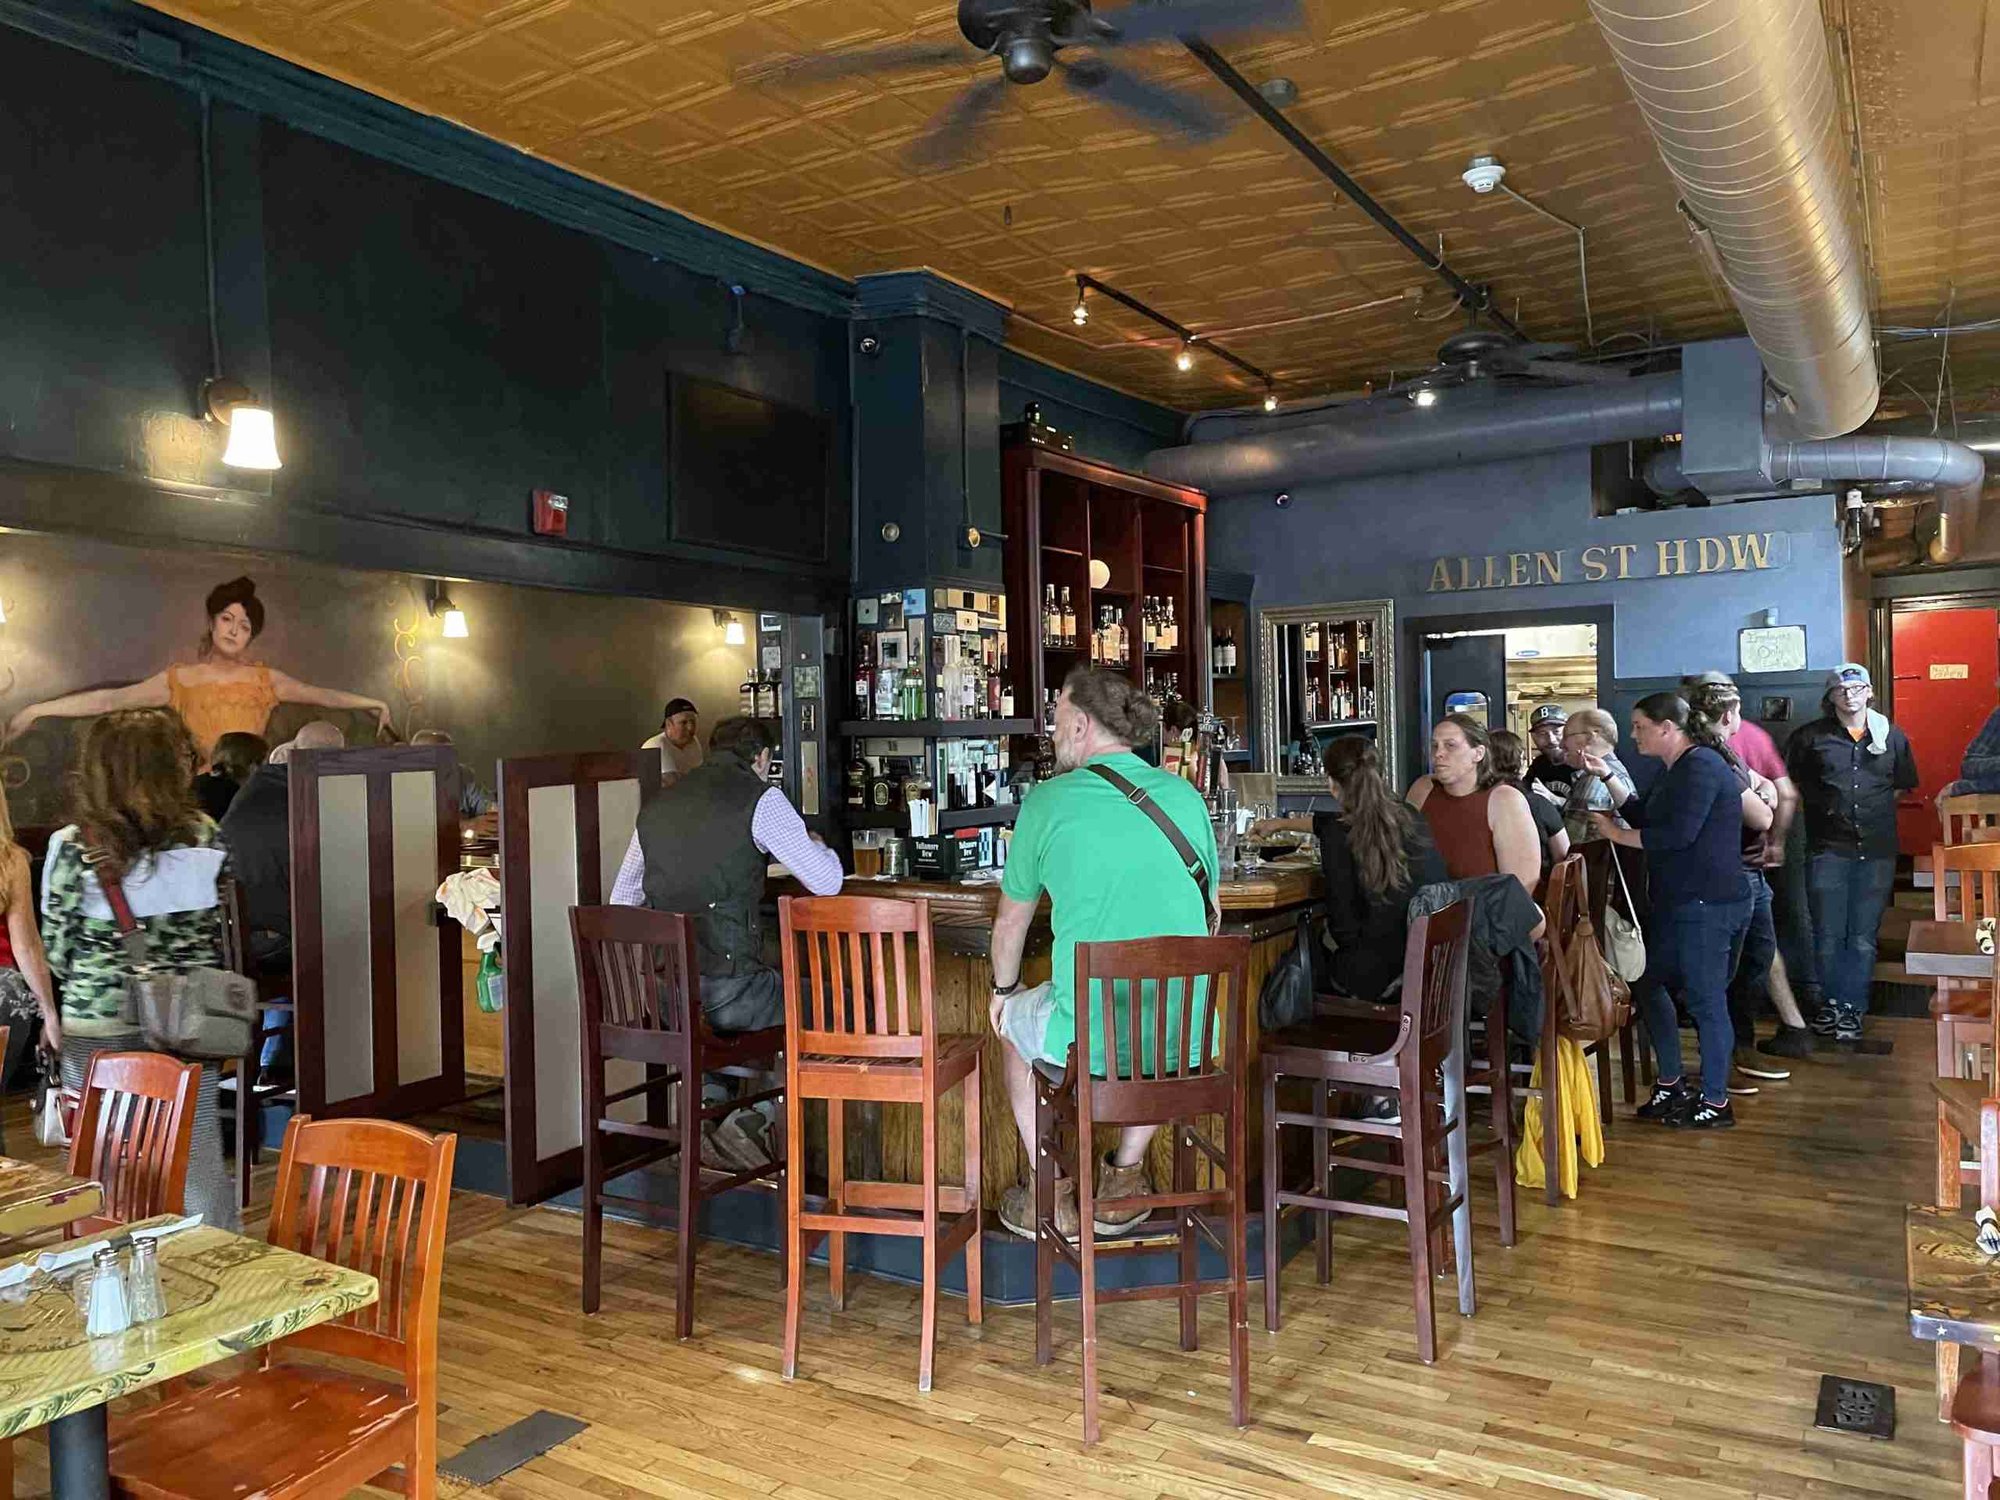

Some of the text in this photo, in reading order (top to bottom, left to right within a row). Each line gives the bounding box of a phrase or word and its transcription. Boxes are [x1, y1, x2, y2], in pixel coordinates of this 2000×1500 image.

[1426, 533, 1774, 593] ALLEN ST HDW
[1540, 706, 1549, 718] B
